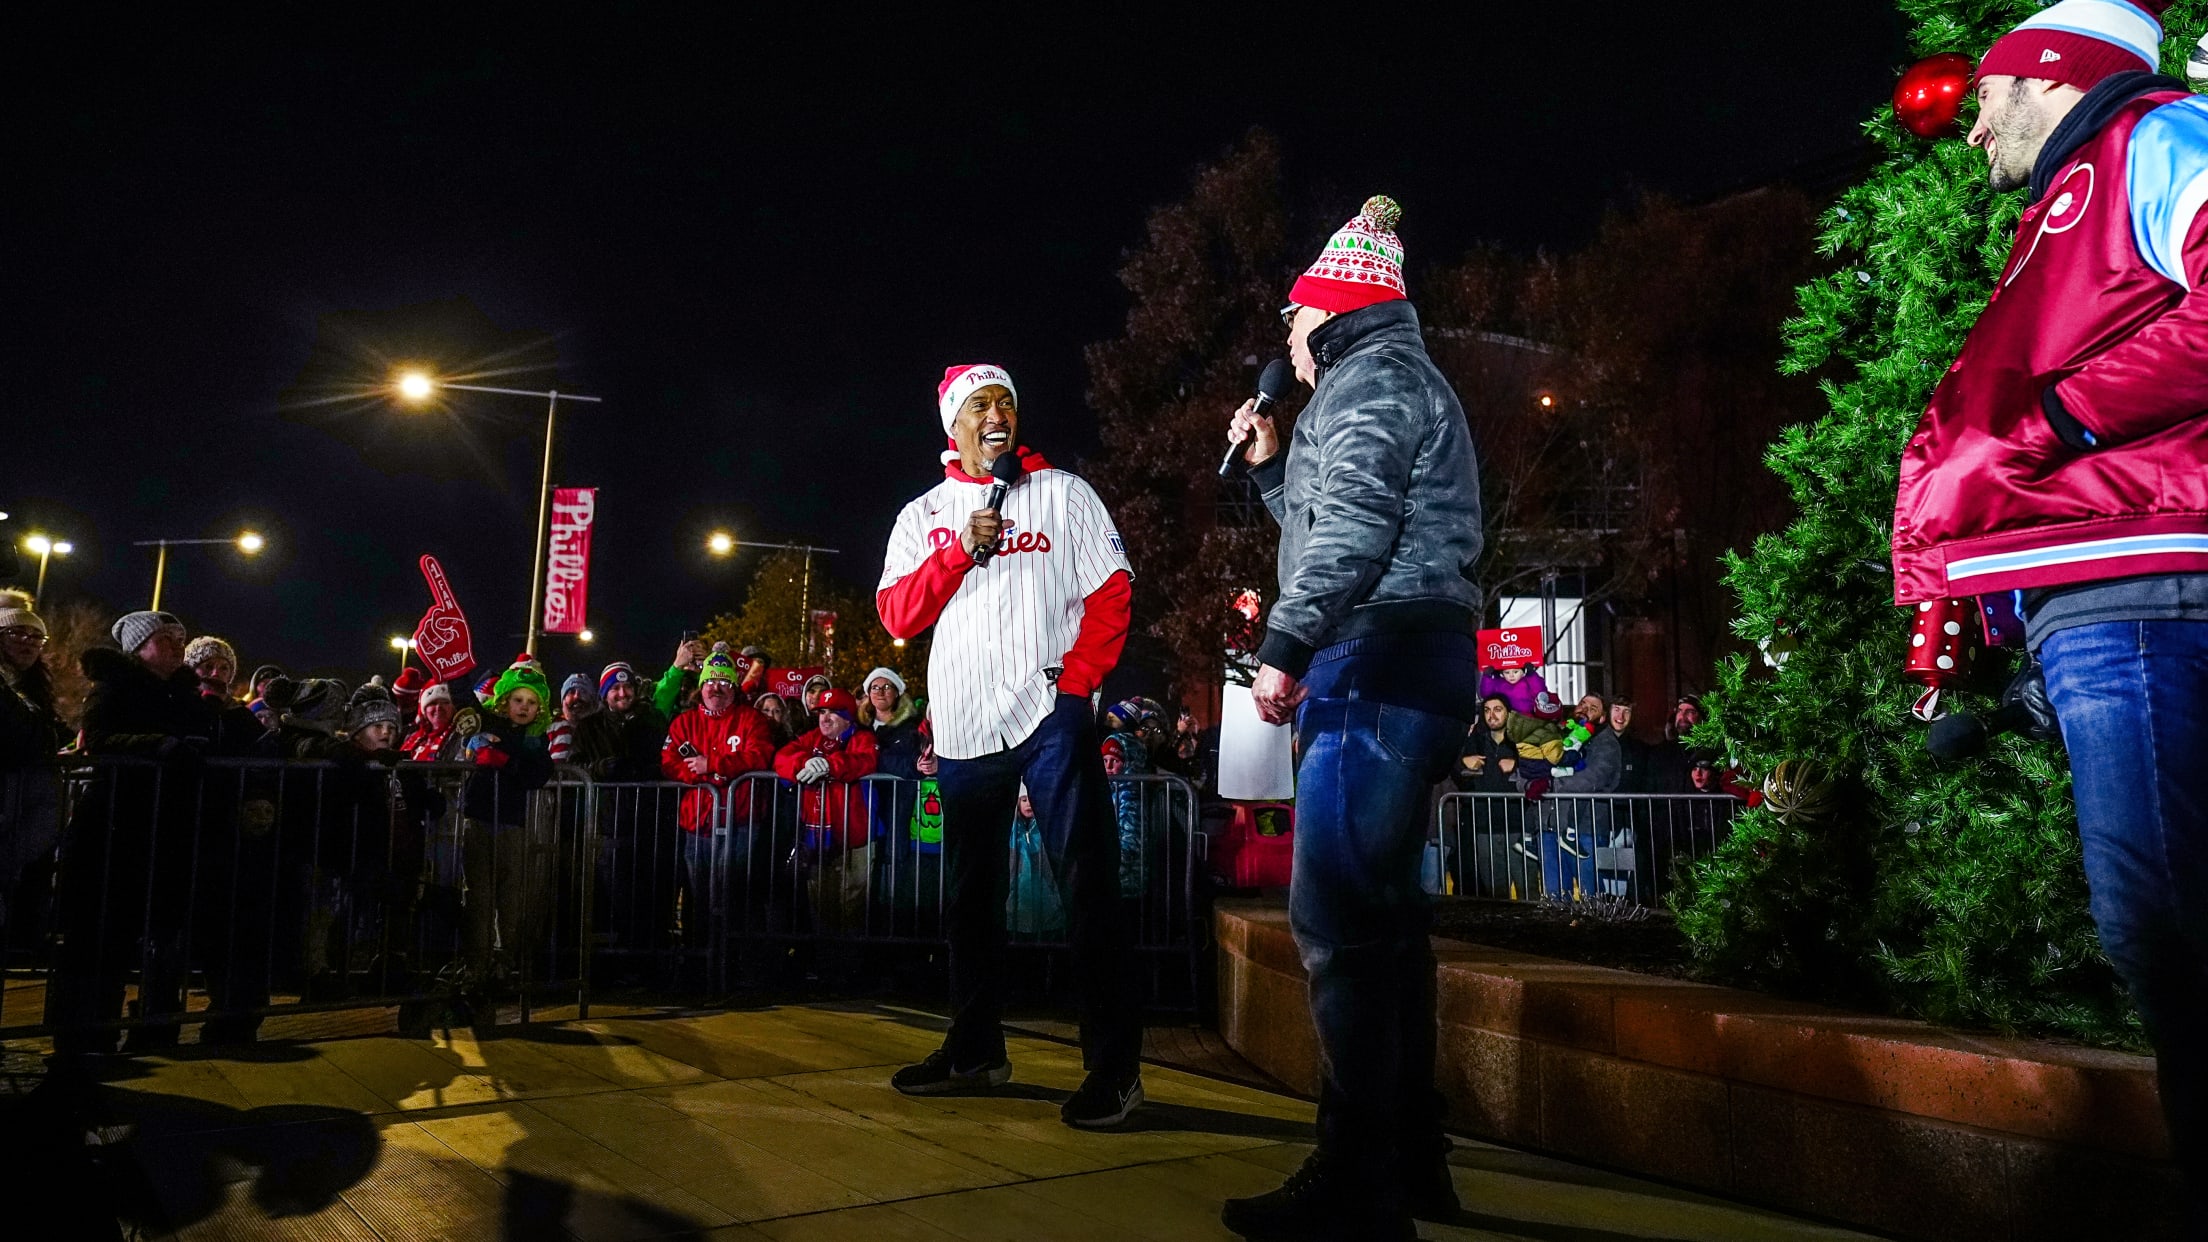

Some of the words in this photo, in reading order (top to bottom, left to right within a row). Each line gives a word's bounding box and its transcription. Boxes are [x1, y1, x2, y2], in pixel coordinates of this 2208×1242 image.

[544, 489, 594, 630] Phillies
[438, 580, 454, 610] FAN
[1501, 631, 1517, 642] Go
[1488, 644, 1532, 659] Phillies
[736, 657, 750, 670] Go
[787, 671, 803, 681] Go
[823, 692, 833, 703] P
[726, 735, 741, 753] P
